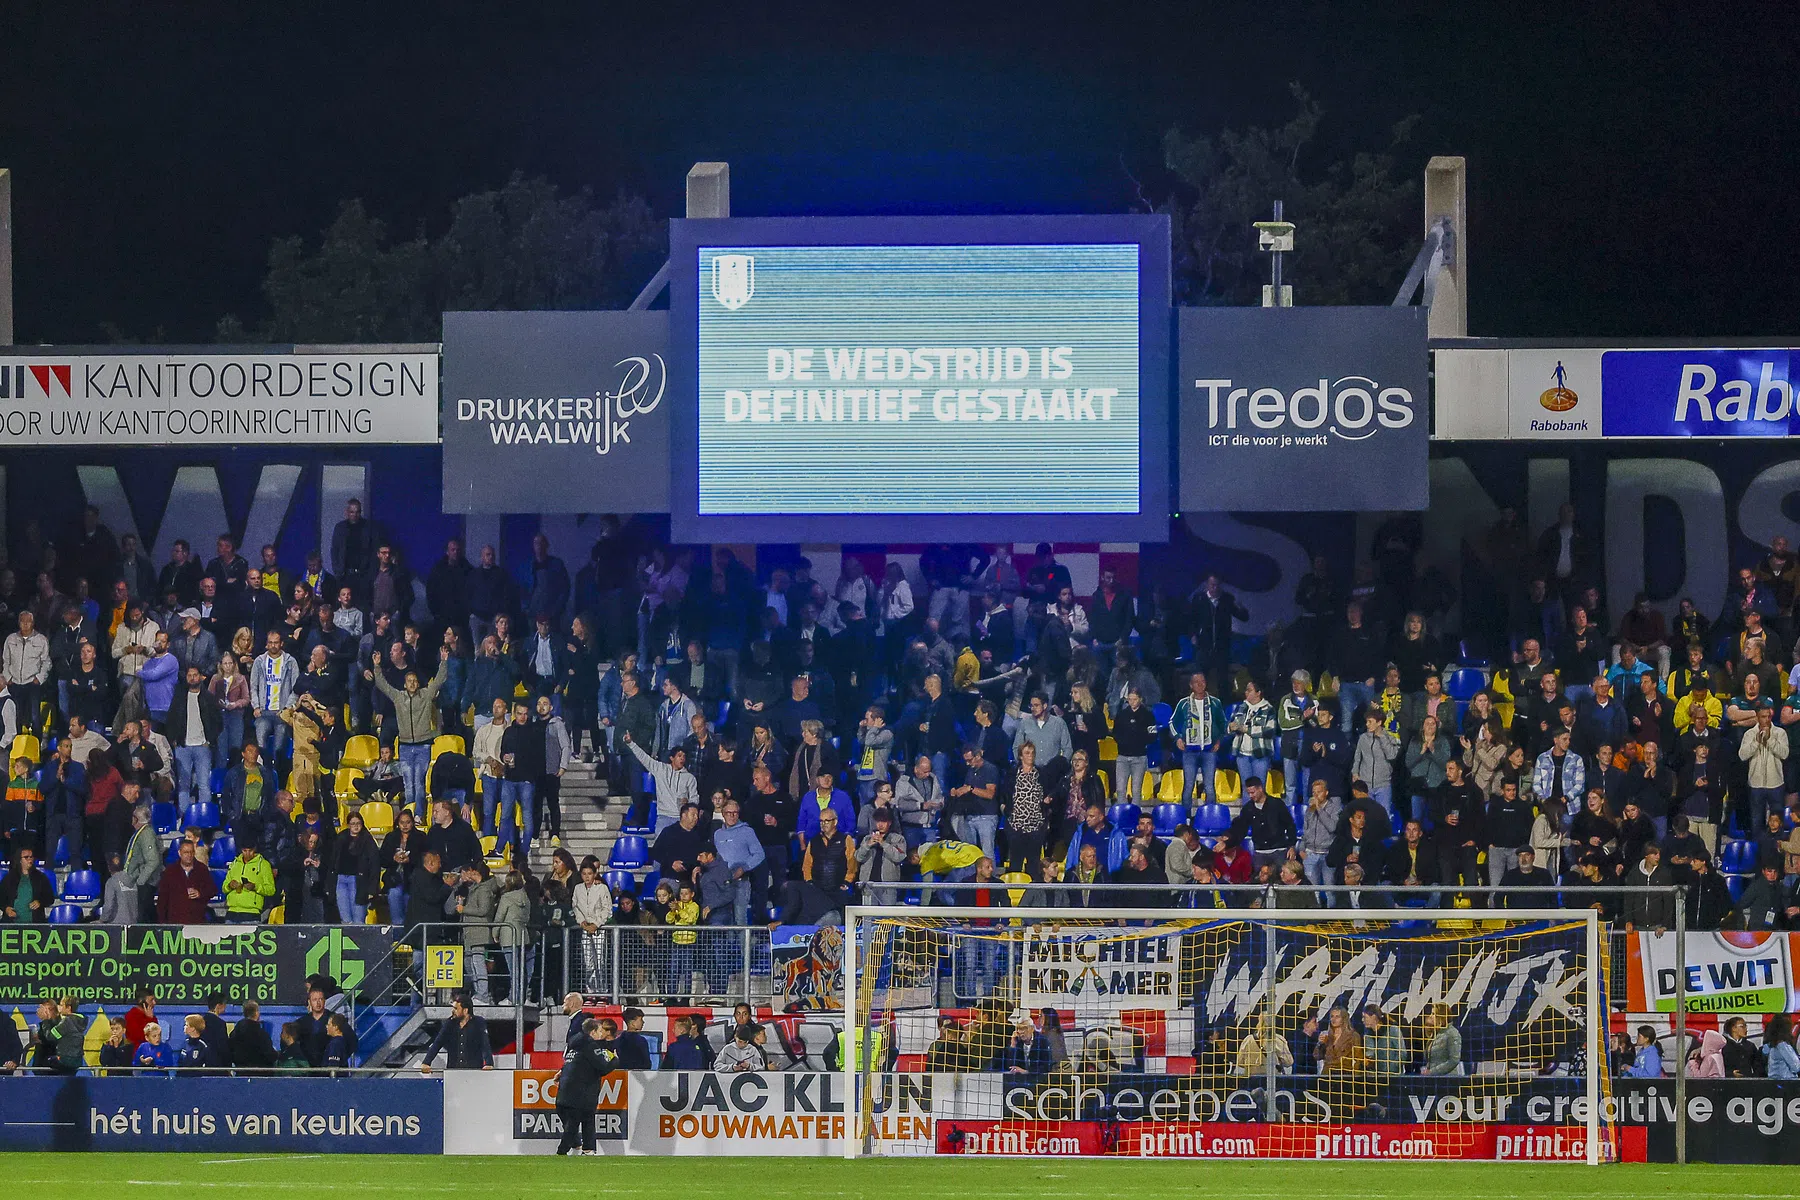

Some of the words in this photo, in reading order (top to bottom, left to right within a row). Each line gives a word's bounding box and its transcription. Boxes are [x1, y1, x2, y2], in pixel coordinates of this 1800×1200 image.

[767, 348, 813, 381] DE
[824, 347, 1030, 382] WEDSTRIJD
[1041, 347, 1073, 379] IS
[85, 361, 425, 398] KANTOORDESIGN
[1674, 362, 1800, 422] Rab
[724, 390, 922, 423] DEFINITIEF
[932, 388, 1119, 421] GESTAAKT
[1195, 378, 1414, 429] Tredos
[50, 410, 92, 436] UW
[100, 408, 372, 436] KANTOORINRICHTING
[1530, 419, 1589, 432] Rabobank
[1208, 435, 1229, 446] ICT
[1232, 434, 1250, 446] die
[1253, 436, 1278, 446] voor
[1280, 434, 1292, 448] je
[1295, 434, 1328, 446] werkt
[435, 950, 455, 966] 12
[1028, 934, 1174, 963] MICHIEL
[101, 958, 141, 981] Op-
[147, 963, 172, 977] en
[180, 958, 278, 982] Overslag
[436, 969, 453, 980] EE
[1657, 965, 1704, 996] DE
[1707, 957, 1779, 990] WIT
[154, 983, 186, 1000] 073
[229, 983, 249, 999] 61
[257, 983, 277, 999] 61
[1683, 994, 1764, 1012] SCHIJNDEL
[522, 1078, 623, 1104] BOW
[660, 1072, 769, 1113] JAC
[90, 1106, 142, 1135] hét
[152, 1107, 216, 1135] huis
[227, 1113, 281, 1135] van
[291, 1107, 421, 1136] keukens
[521, 1113, 621, 1134] PARER
[1408, 1094, 1512, 1124] your
[965, 1125, 1080, 1154] print.com
[1140, 1125, 1255, 1157] print.com
[1315, 1126, 1433, 1158] print.com
[1496, 1127, 1616, 1159] print.cm
